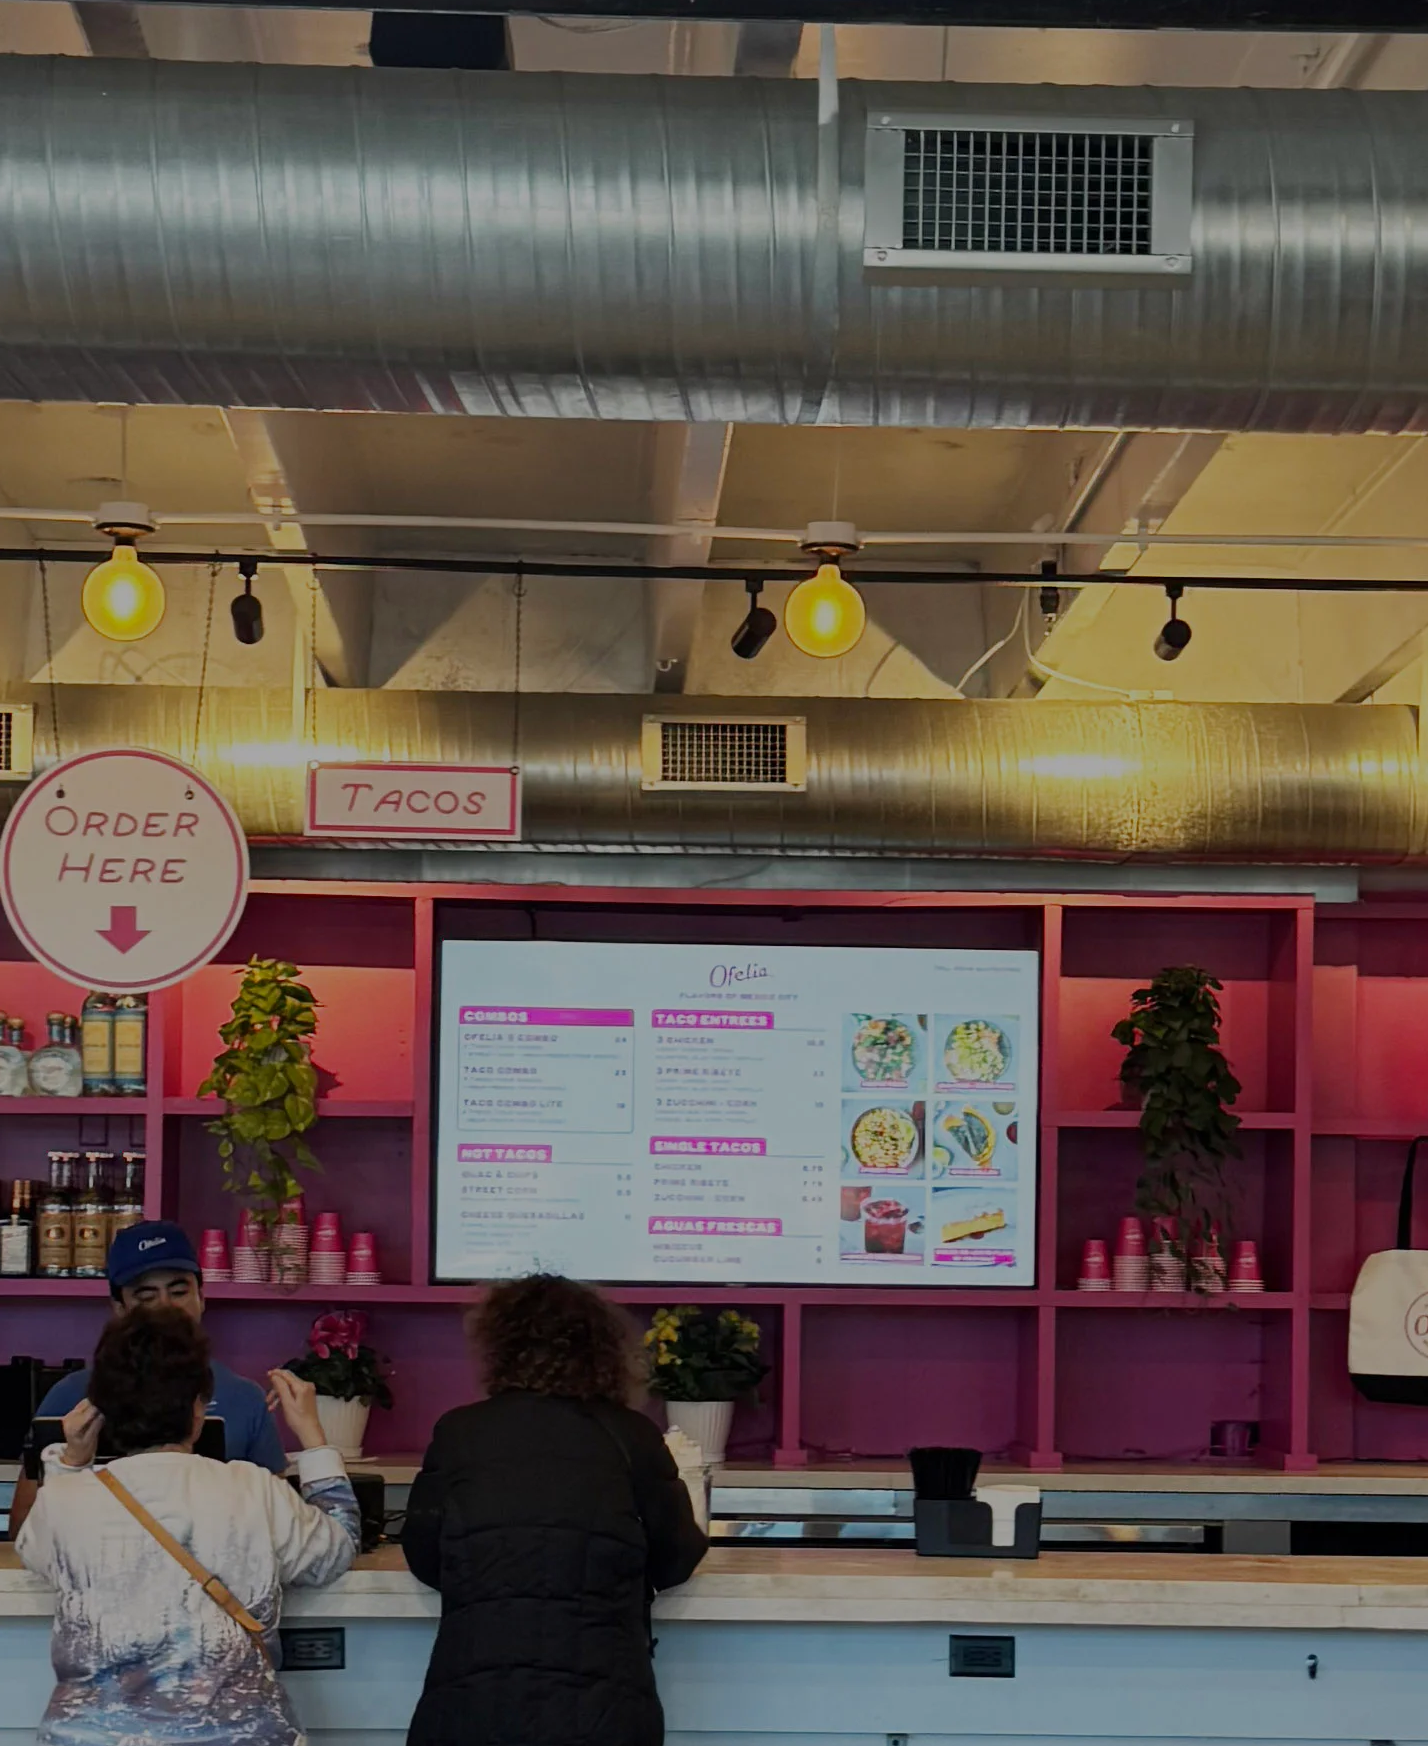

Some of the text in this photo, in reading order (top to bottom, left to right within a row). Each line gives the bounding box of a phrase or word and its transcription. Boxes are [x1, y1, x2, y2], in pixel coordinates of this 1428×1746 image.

[341, 783, 486, 815] TACOS
[45, 805, 199, 837] ORDER
[58, 853, 187, 883] HERE
[709, 962, 774, 988] Ofelia
[464, 1011, 528, 1022] COMBOS
[656, 1013, 769, 1026] TACO ENTREES
[667, 1036, 714, 1044] CHICKEN
[464, 1066, 494, 1074] TACO
[497, 1067, 537, 1075] COMBO
[464, 1099, 493, 1107] TACO
[497, 1100, 536, 1108] COMBO
[539, 1100, 563, 1108] LITE
[654, 1141, 761, 1153] SINGLE TACOS
[461, 1148, 547, 1161] NOT TACOS
[461, 1186, 503, 1194] STREET
[652, 1220, 776, 1233] AGUAS FRESCAS
